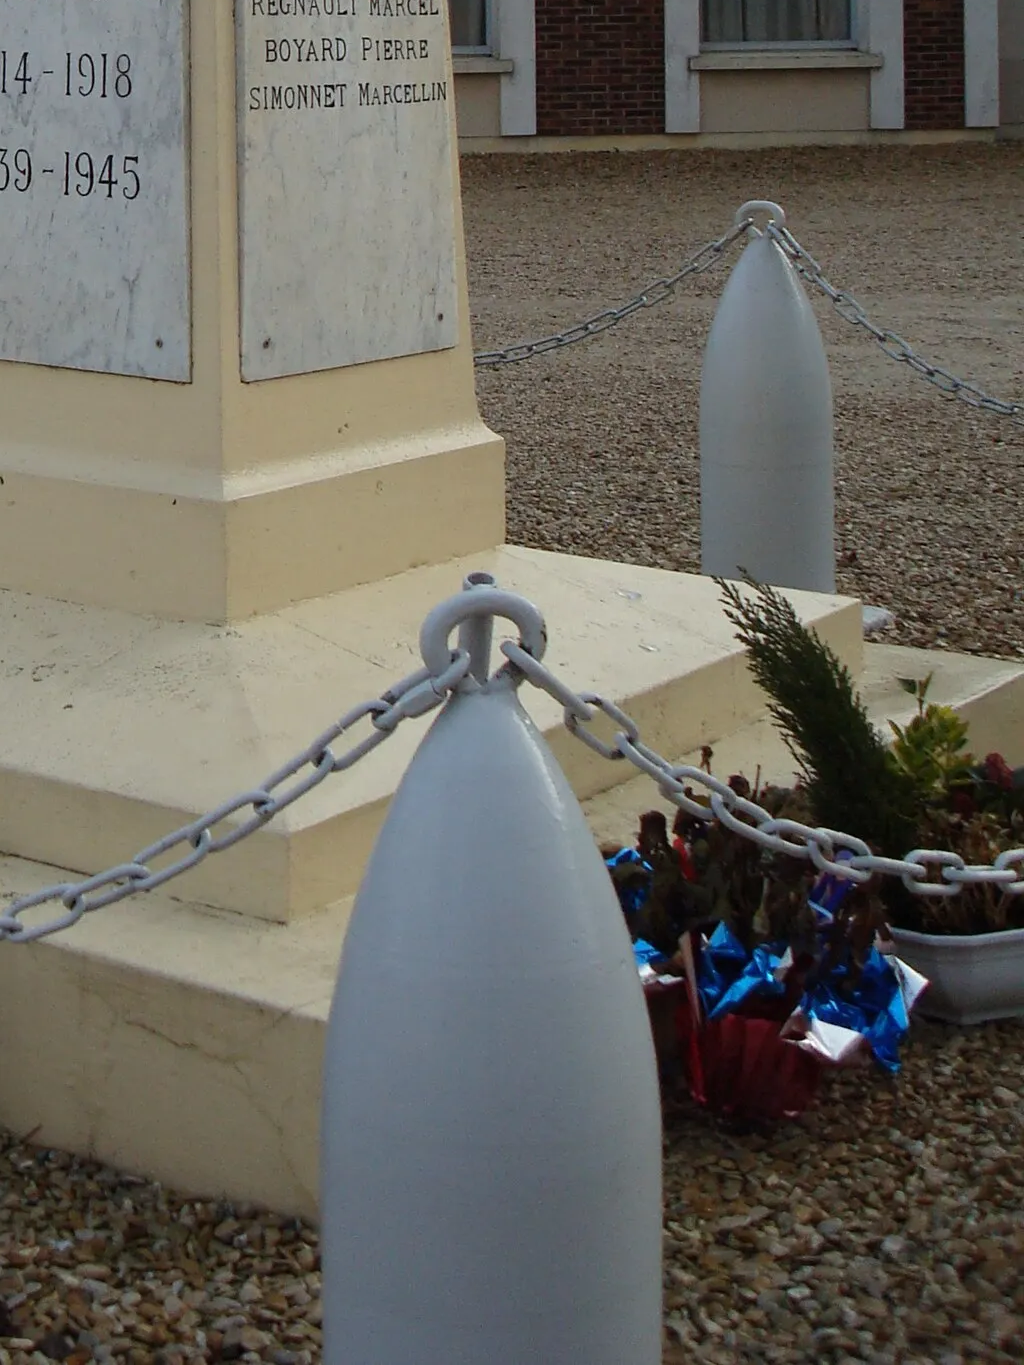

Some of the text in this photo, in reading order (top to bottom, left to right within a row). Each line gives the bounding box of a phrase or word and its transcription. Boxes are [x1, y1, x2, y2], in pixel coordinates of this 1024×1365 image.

[265, 37, 429, 63] BOYARD PIERRE
[249, 81, 448, 111] SIMONNET MARCELLIN
